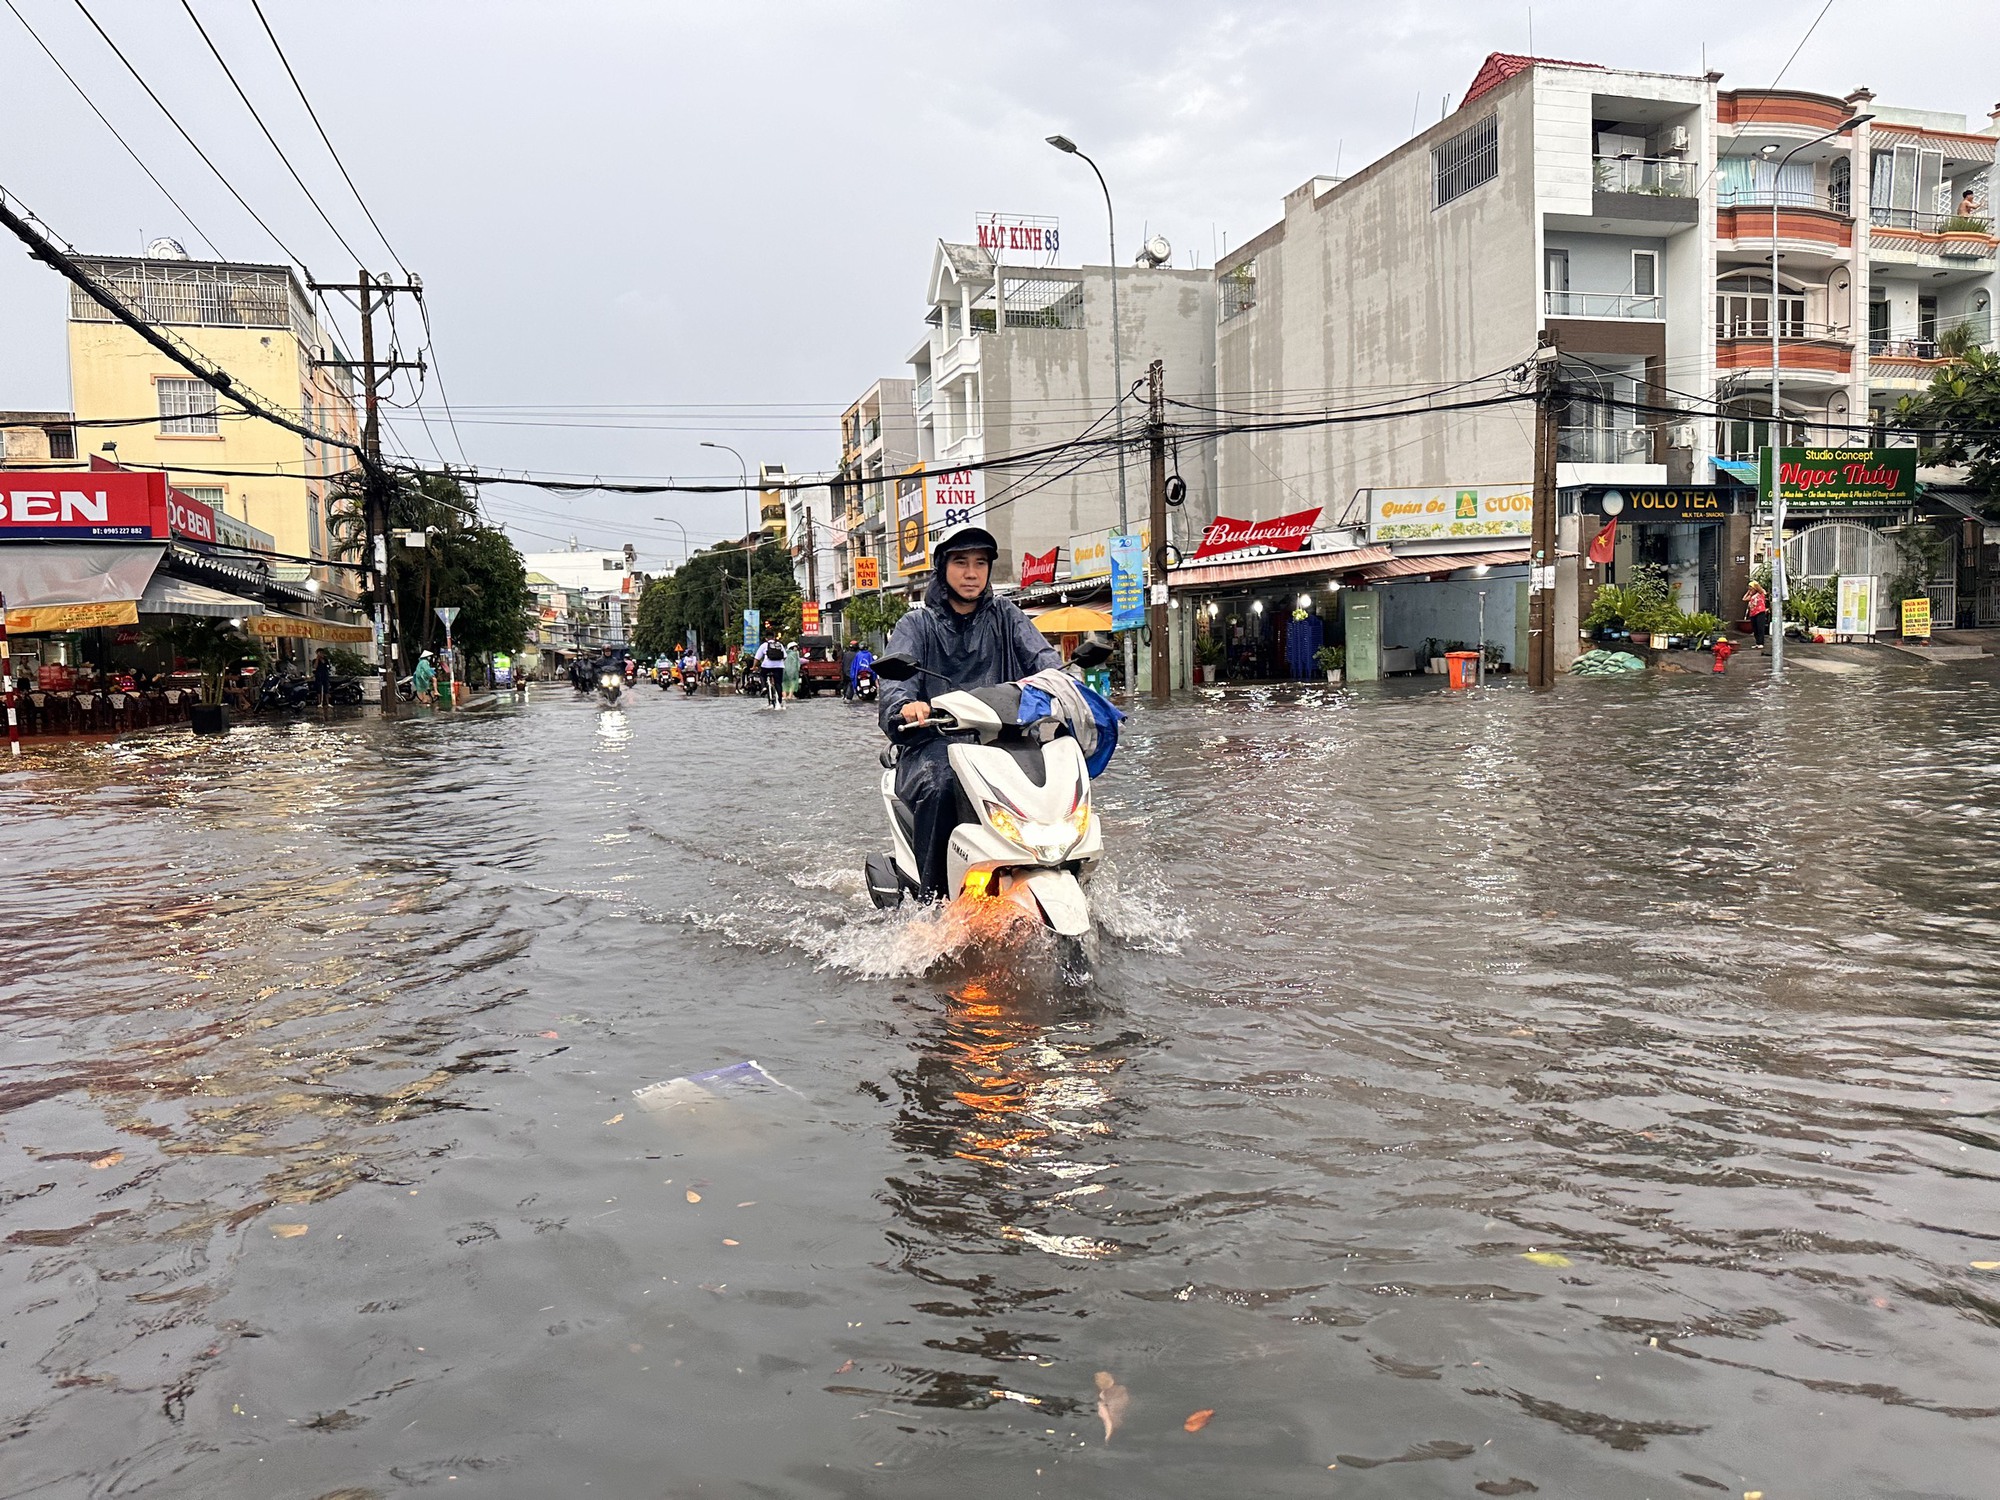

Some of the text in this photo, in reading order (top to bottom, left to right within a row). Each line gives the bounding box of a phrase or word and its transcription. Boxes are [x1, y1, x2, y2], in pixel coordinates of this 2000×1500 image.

[978, 213, 1059, 251] MẮT KÍNH 83
[1805, 449, 1874, 463] Studio Concept
[1780, 462, 1899, 491] Ngọc Thúy
[936, 486, 975, 504] KÍNH
[1629, 491, 1718, 509] YOLO TEA
[1381, 501, 1422, 519] Quán
[1457, 493, 1476, 517] A
[187, 509, 211, 540] BEN
[946, 509, 969, 527] 83
[1201, 521, 1313, 546] Budweiser
[857, 560, 875, 569] MẮT
[1022, 560, 1055, 578] Budweiser
[857, 570, 876, 578] KÍNH
[951, 842, 969, 862] YAMAHA
